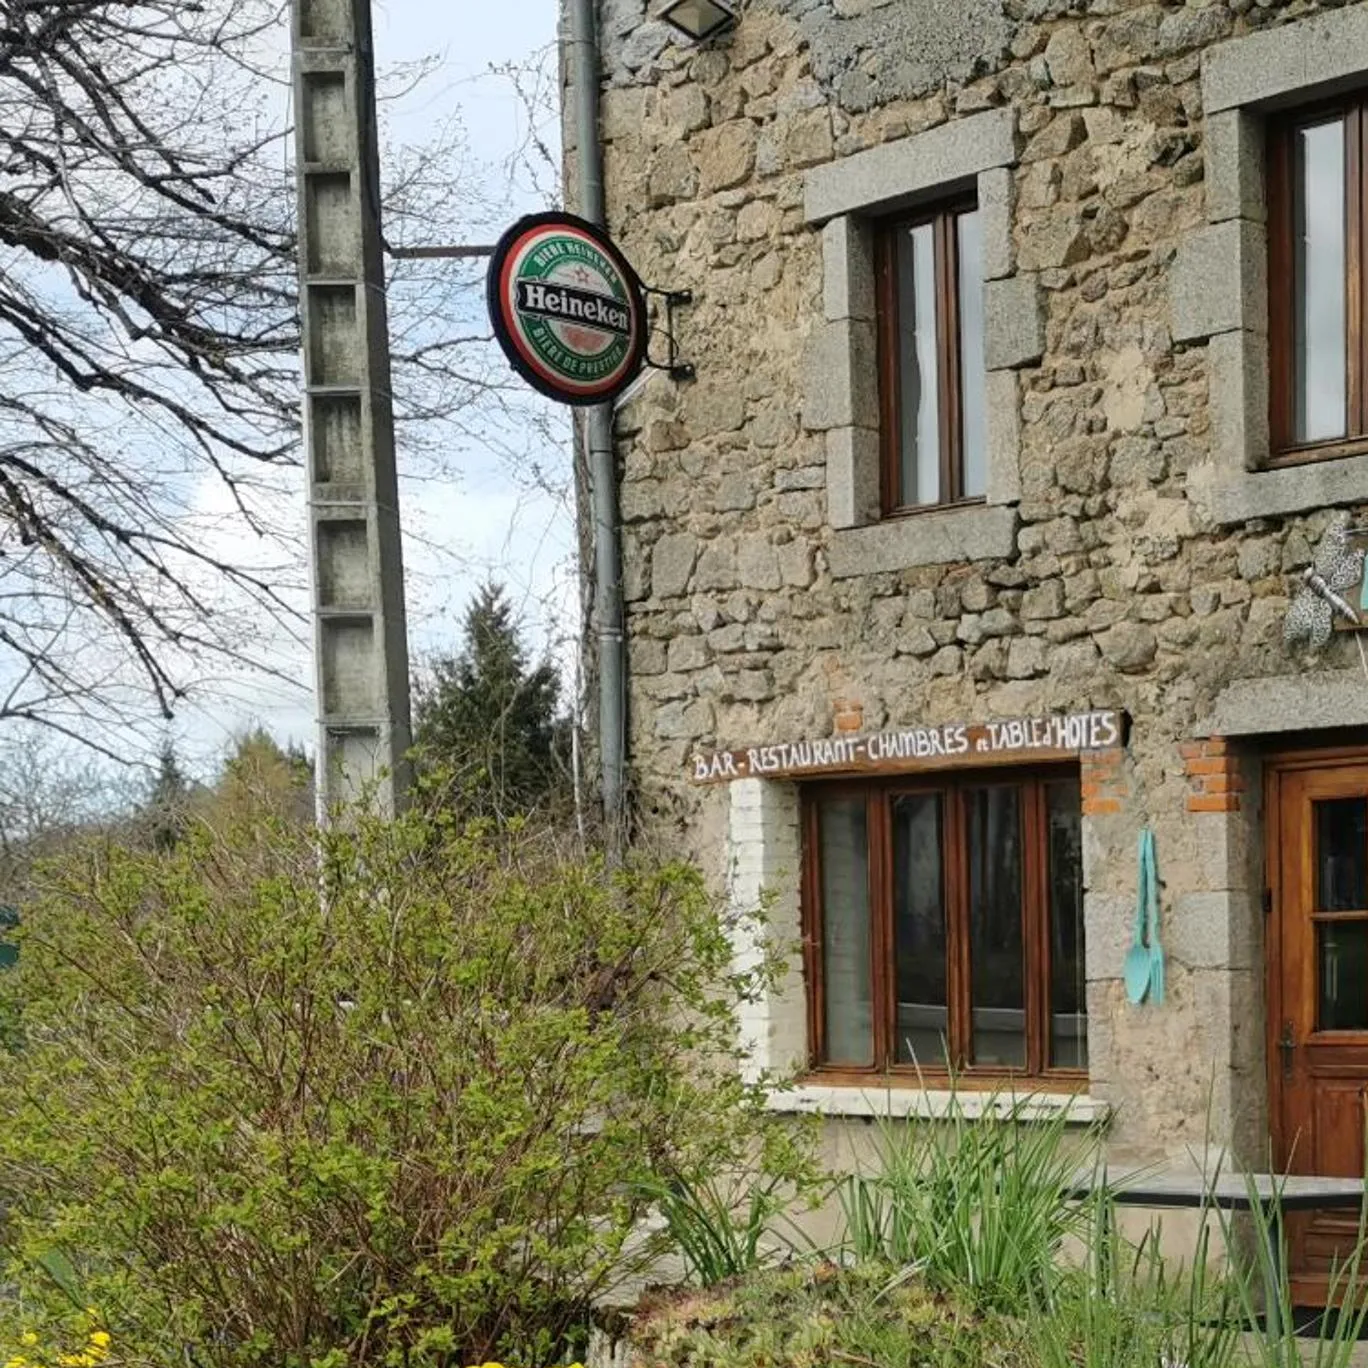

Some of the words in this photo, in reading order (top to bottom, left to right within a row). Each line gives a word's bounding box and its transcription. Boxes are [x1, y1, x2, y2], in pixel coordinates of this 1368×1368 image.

[525, 284, 628, 329] Heineken
[867, 727, 969, 759] CHAMBRES
[986, 718, 1043, 749] TABLE
